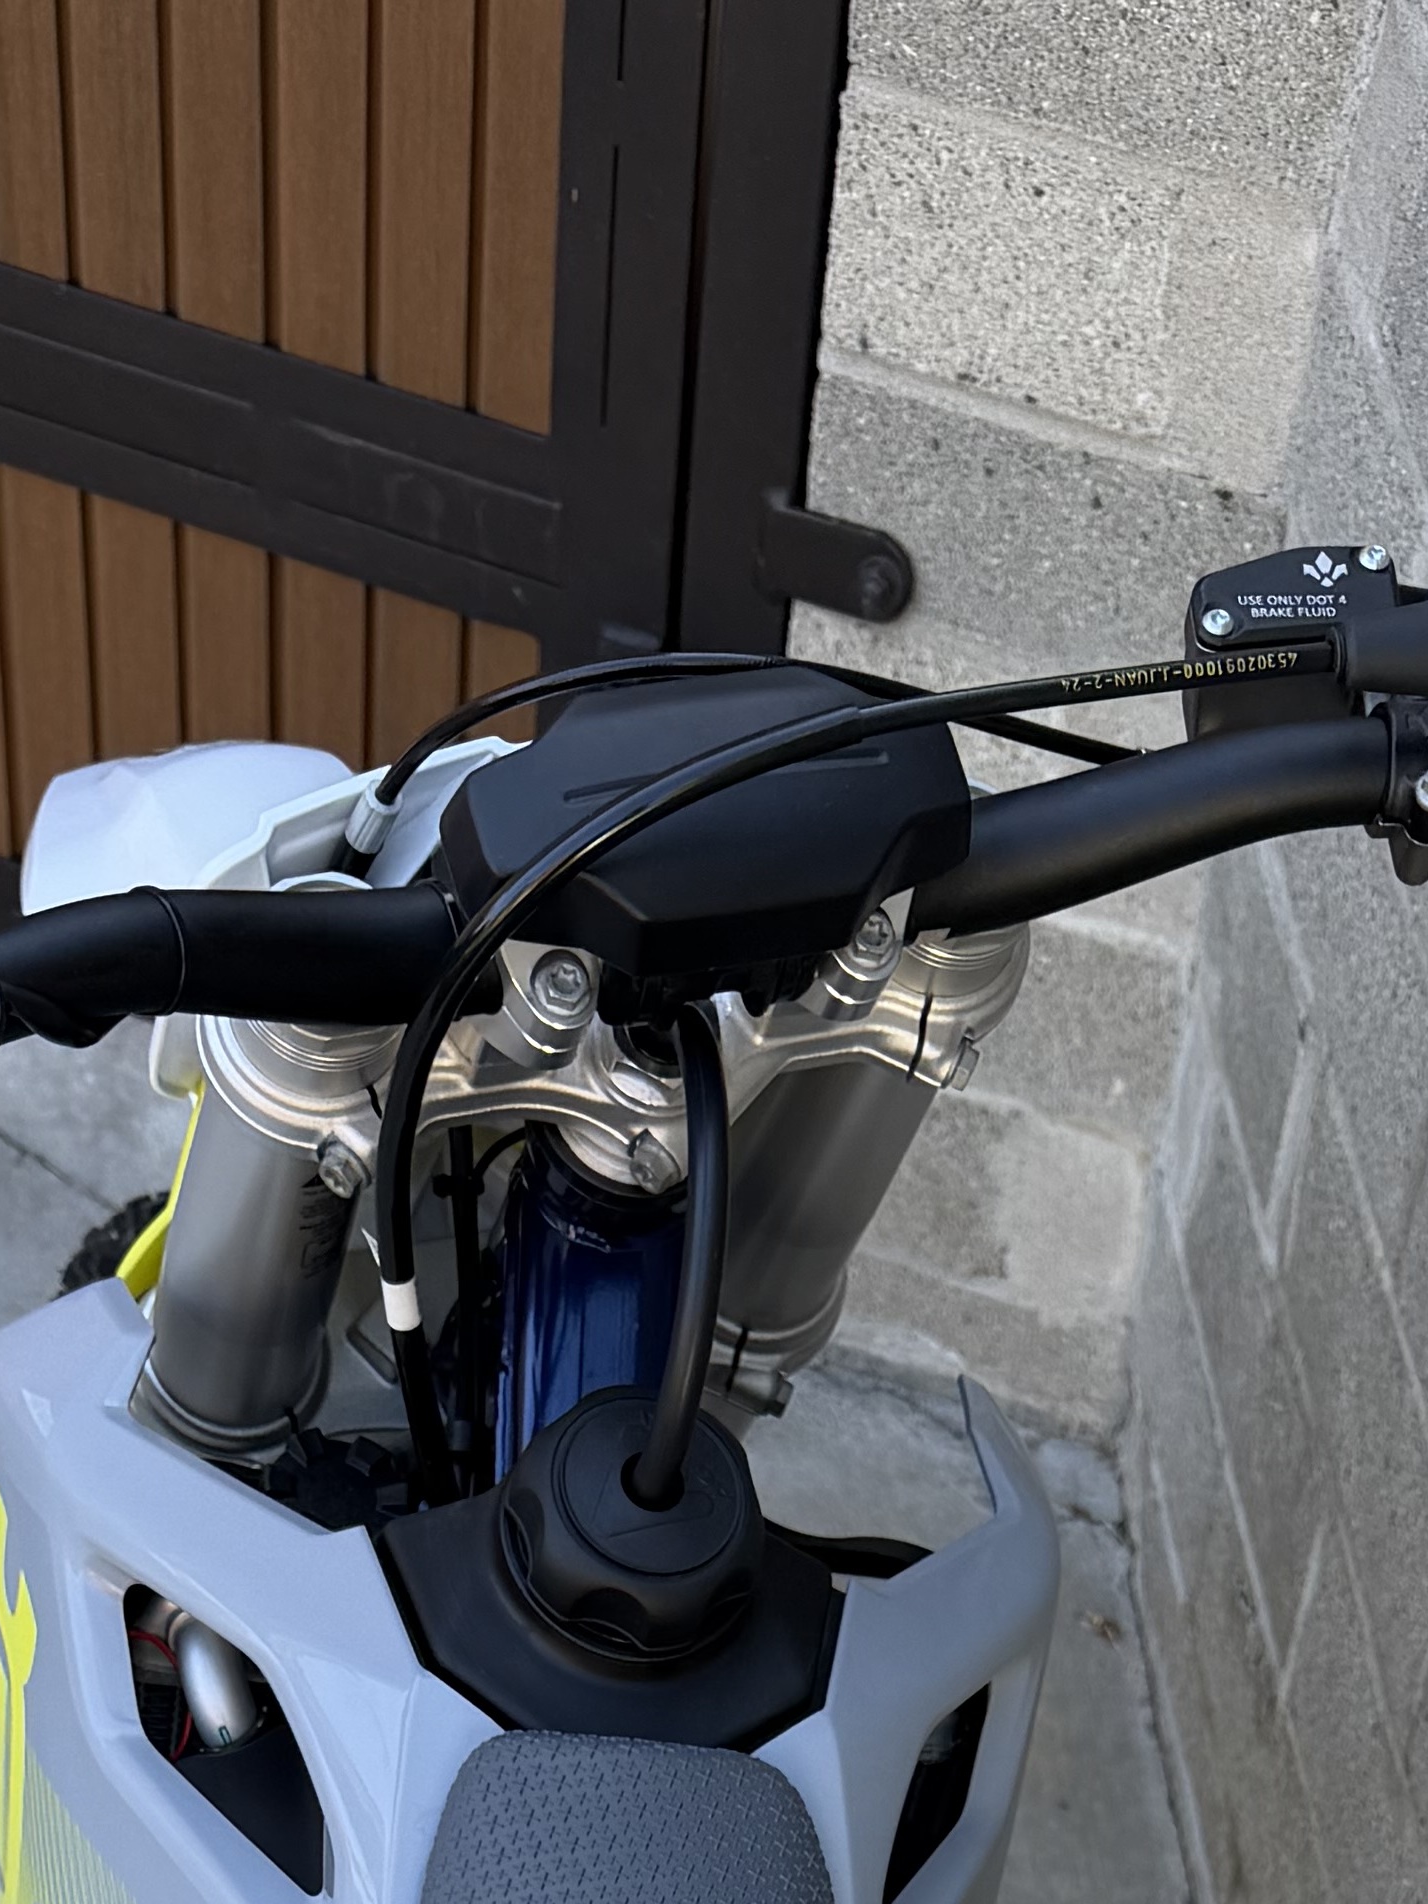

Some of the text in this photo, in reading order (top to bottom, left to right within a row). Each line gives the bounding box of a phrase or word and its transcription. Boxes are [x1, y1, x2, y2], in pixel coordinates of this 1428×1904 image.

[1237, 594, 1348, 605] USE ONLY DOT 4
[1250, 607, 1337, 618] BRAKE FLUID
